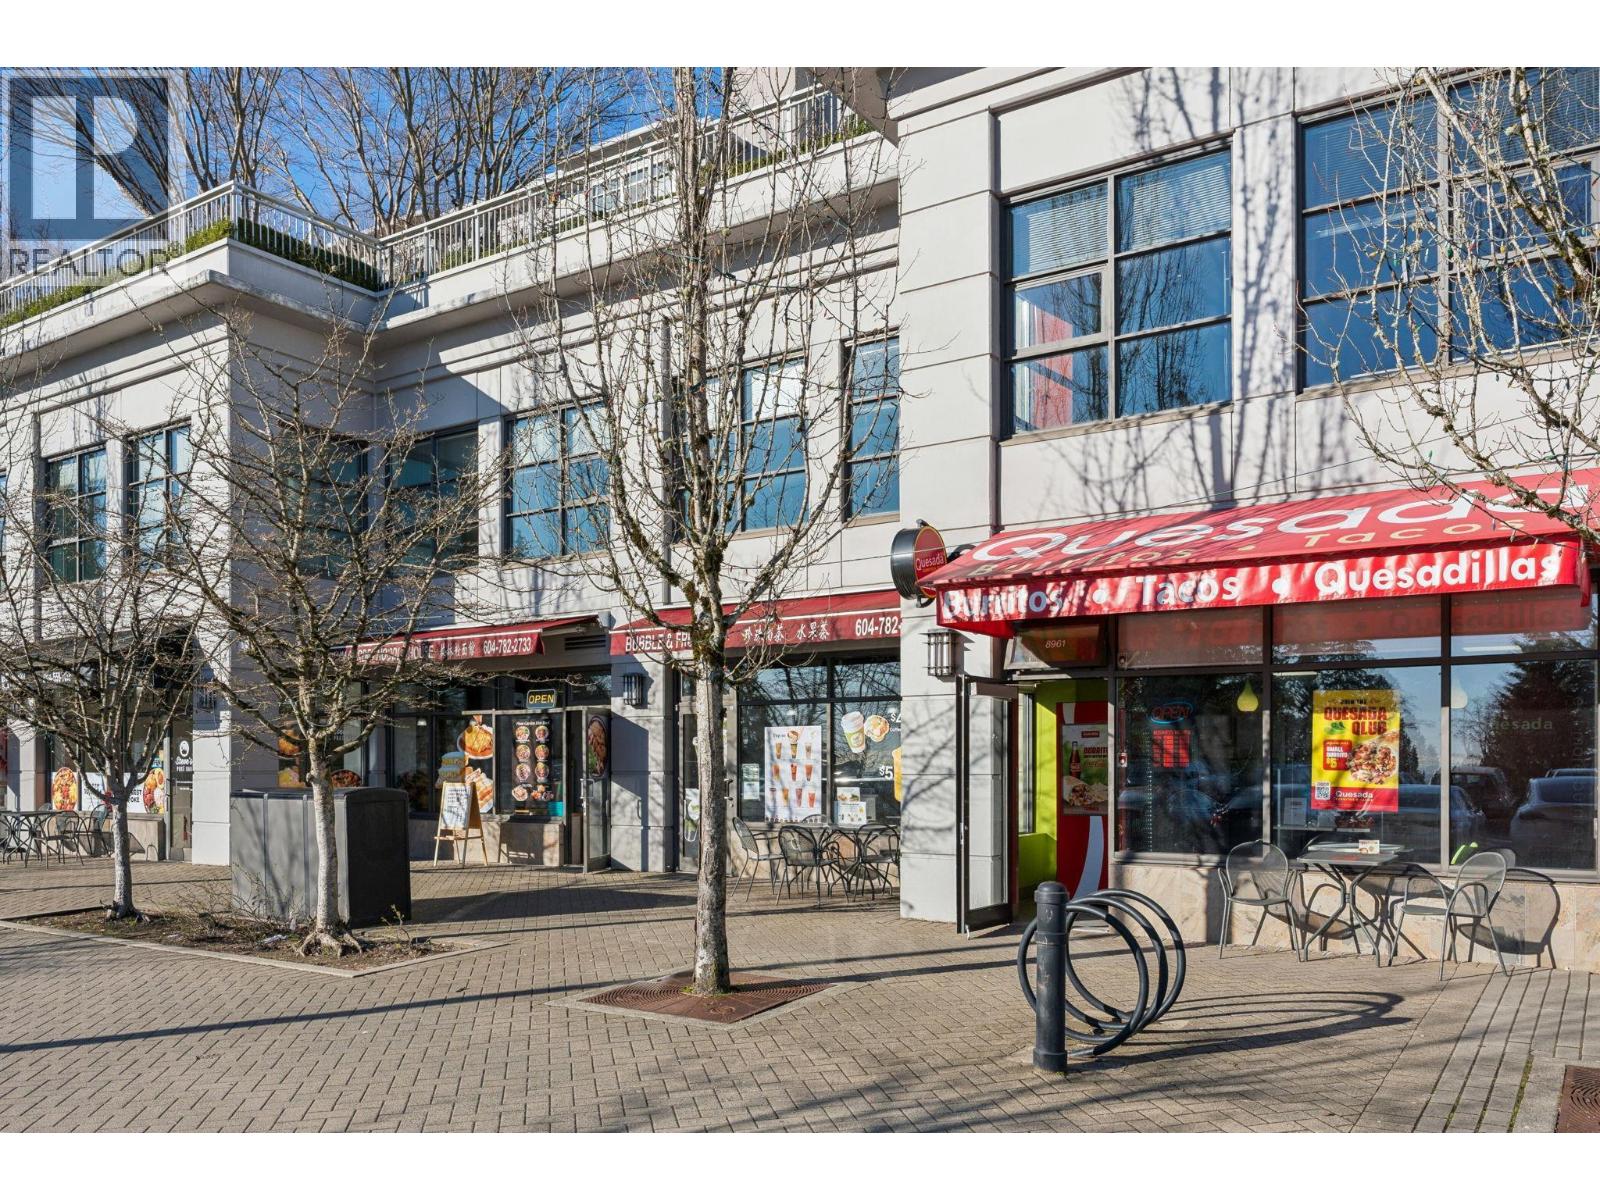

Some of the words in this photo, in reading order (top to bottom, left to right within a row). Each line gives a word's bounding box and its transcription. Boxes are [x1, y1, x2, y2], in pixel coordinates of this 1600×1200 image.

[972, 484, 1589, 562] Quesada
[1303, 519, 1526, 548] Tacos
[916, 553, 944, 571] Quesada
[943, 586, 1063, 619] Burritos
[1136, 576, 1241, 606] Tacos
[1313, 548, 1560, 595] Quesadillas
[483, 637, 532, 655] 604-782-2733
[1045, 639, 1066, 649] 8961
[528, 694, 554, 704] OPEN
[1324, 706, 1387, 721] QUESADA
[1351, 721, 1388, 736] QLUB
[1335, 790, 1374, 799] Quesada
